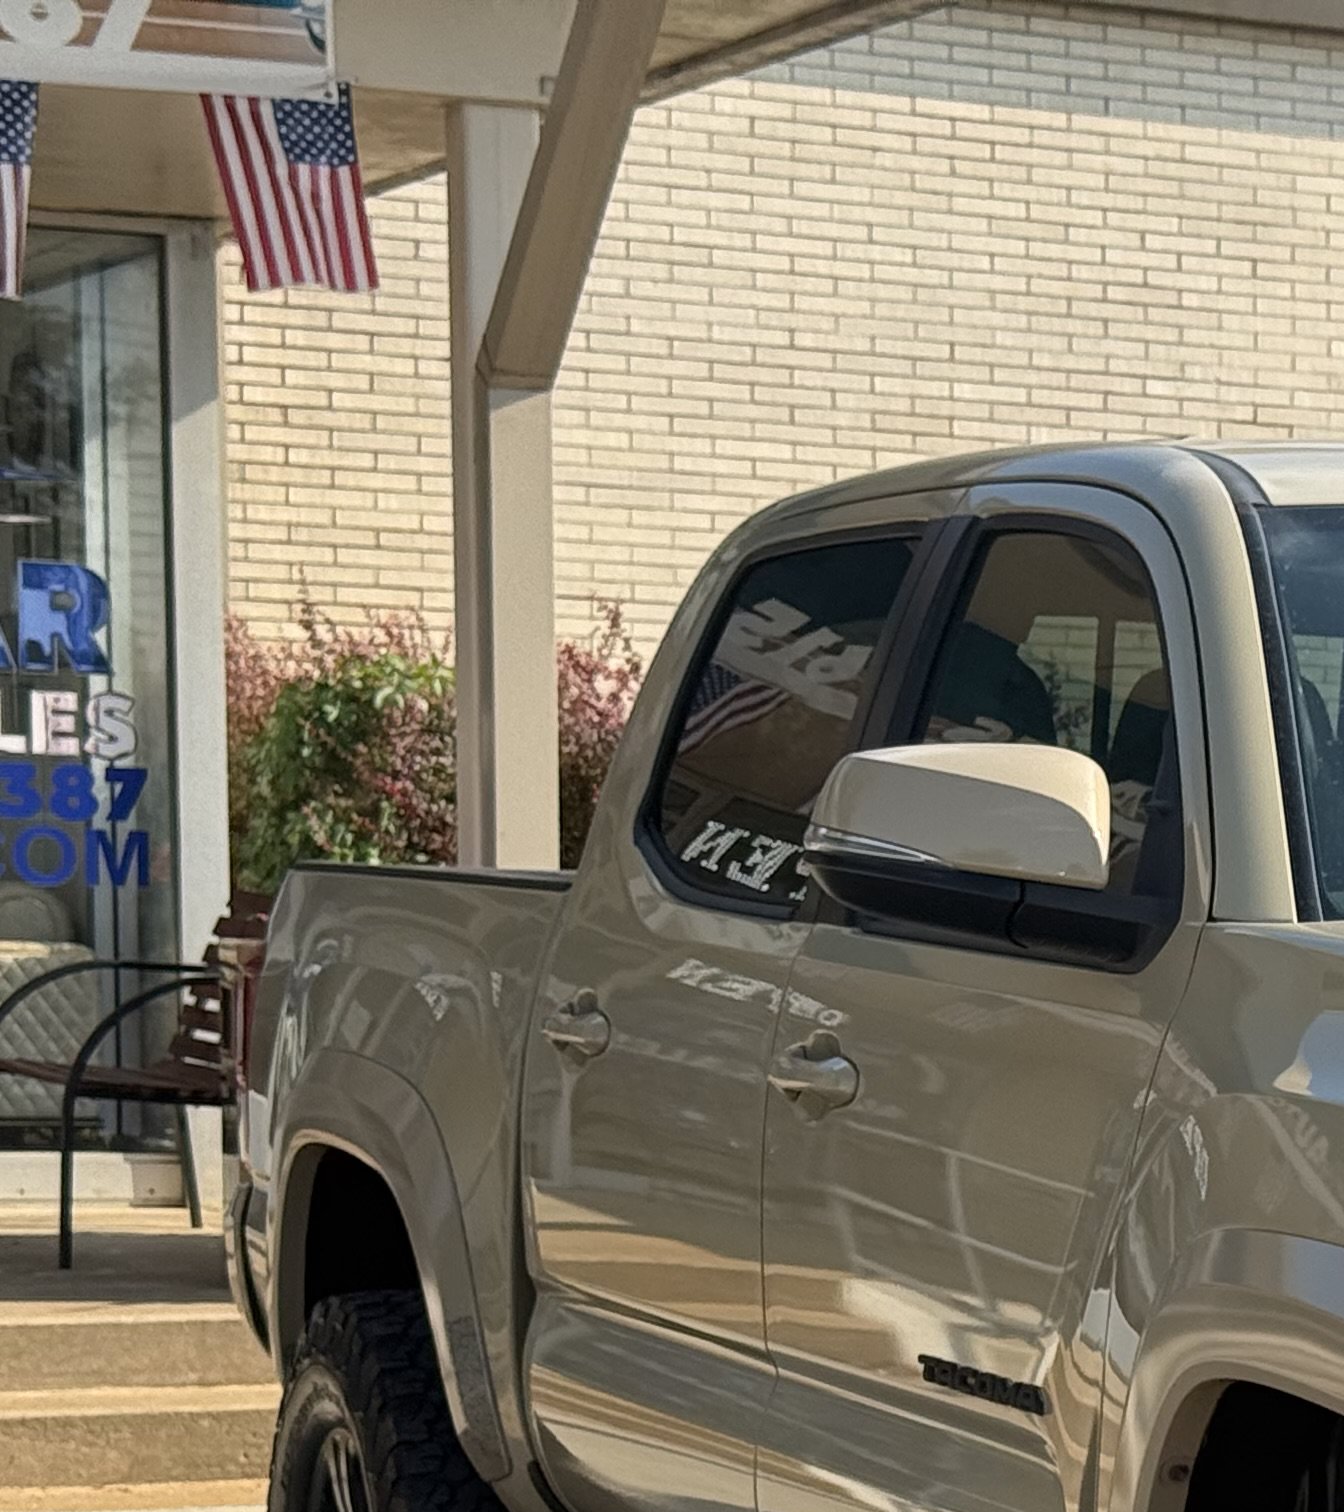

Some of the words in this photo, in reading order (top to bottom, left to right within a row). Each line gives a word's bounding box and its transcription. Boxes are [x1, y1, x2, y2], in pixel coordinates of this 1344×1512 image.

[0, 560, 113, 676] R
[0, 761, 149, 822] 387
[0, 824, 150, 887] OM
[917, 1353, 1047, 1417] TACOMA
